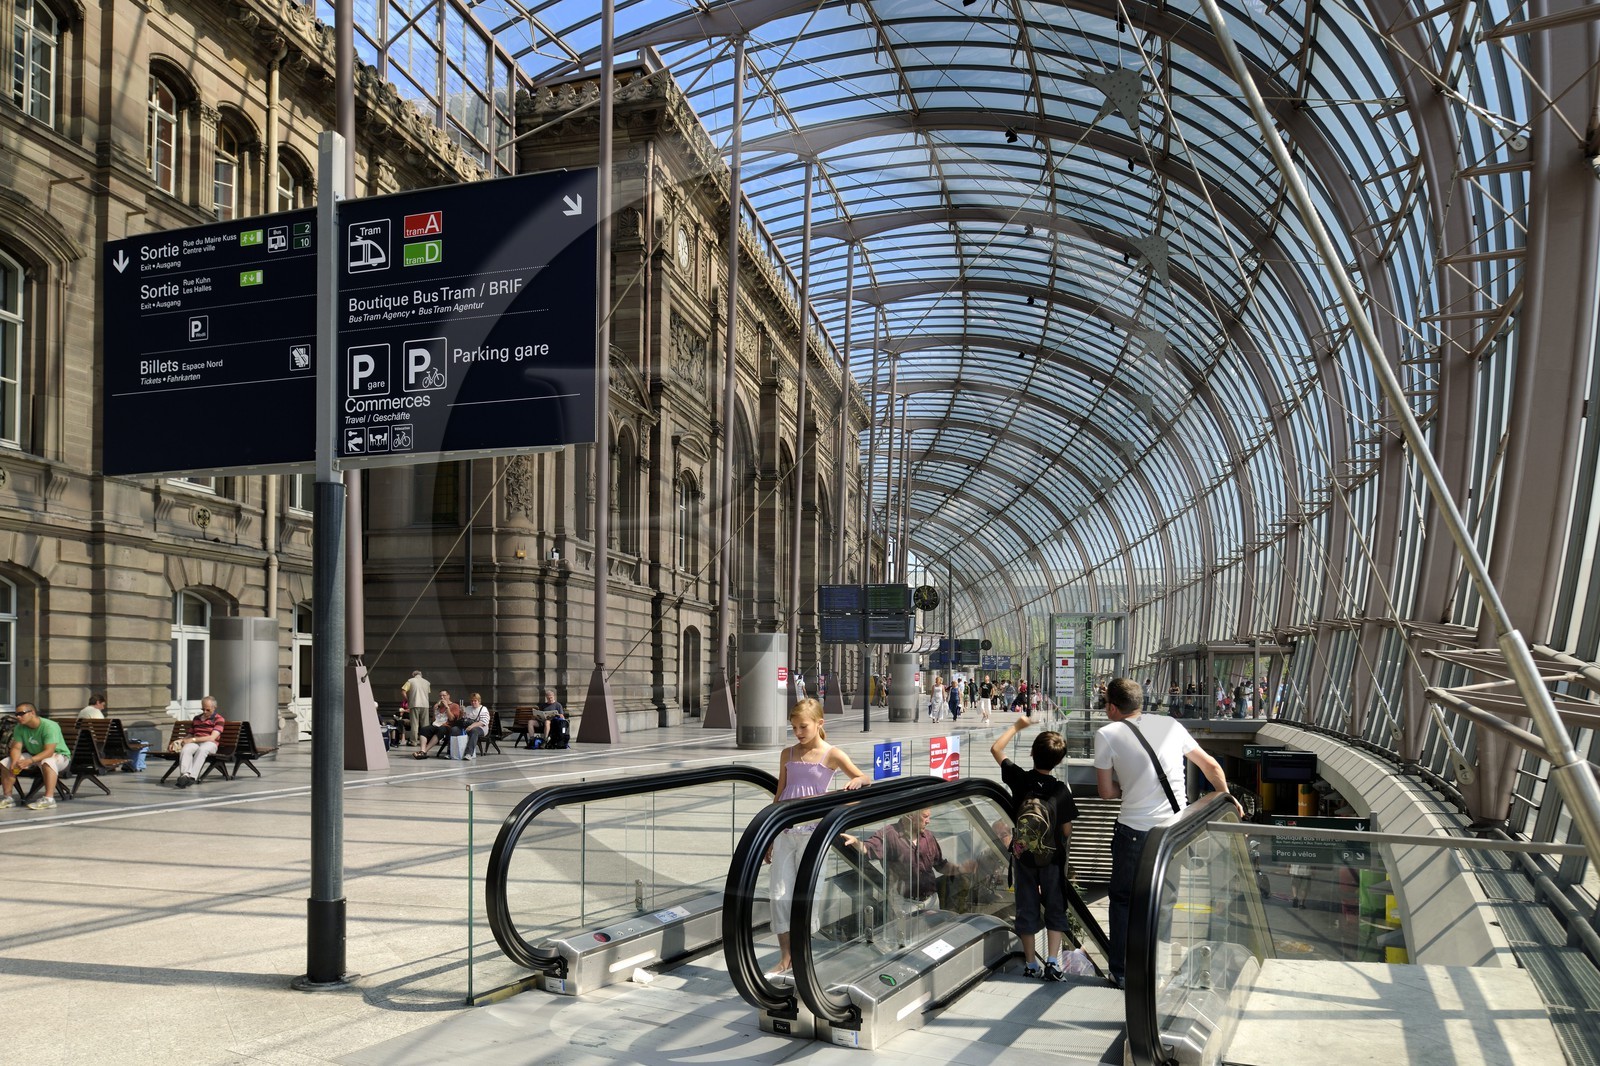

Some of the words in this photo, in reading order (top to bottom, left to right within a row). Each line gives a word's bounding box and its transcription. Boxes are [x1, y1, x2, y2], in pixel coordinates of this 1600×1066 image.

[304, 224, 310, 232] 2
[360, 226, 381, 236] Tram
[406, 227, 425, 236] tram
[424, 214, 440, 234] A
[204, 236, 222, 244] Maire
[301, 238, 310, 246] 10
[140, 242, 180, 260] Sortie
[426, 243, 439, 262] D
[156, 260, 181, 269] Ausgang
[140, 282, 180, 300] Sortie
[349, 294, 408, 312] Boutique
[414, 290, 439, 304] Bus
[440, 286, 476, 300] Tram
[490, 278, 522, 296] BRIF
[156, 300, 181, 308] Ausgang
[382, 310, 410, 320] Agency
[452, 302, 484, 312] Agentur
[192, 320, 202, 338] P
[454, 345, 509, 363] Parking
[514, 344, 549, 361] gare
[140, 360, 178, 374] Billets
[182, 362, 204, 371] Espace
[206, 360, 223, 368] Nord
[353, 354, 375, 390] P
[408, 348, 431, 384] P
[167, 374, 200, 382] Fahrkarten
[368, 380, 386, 390] gare
[345, 395, 430, 413] Commerces
[345, 415, 366, 424] Travel
